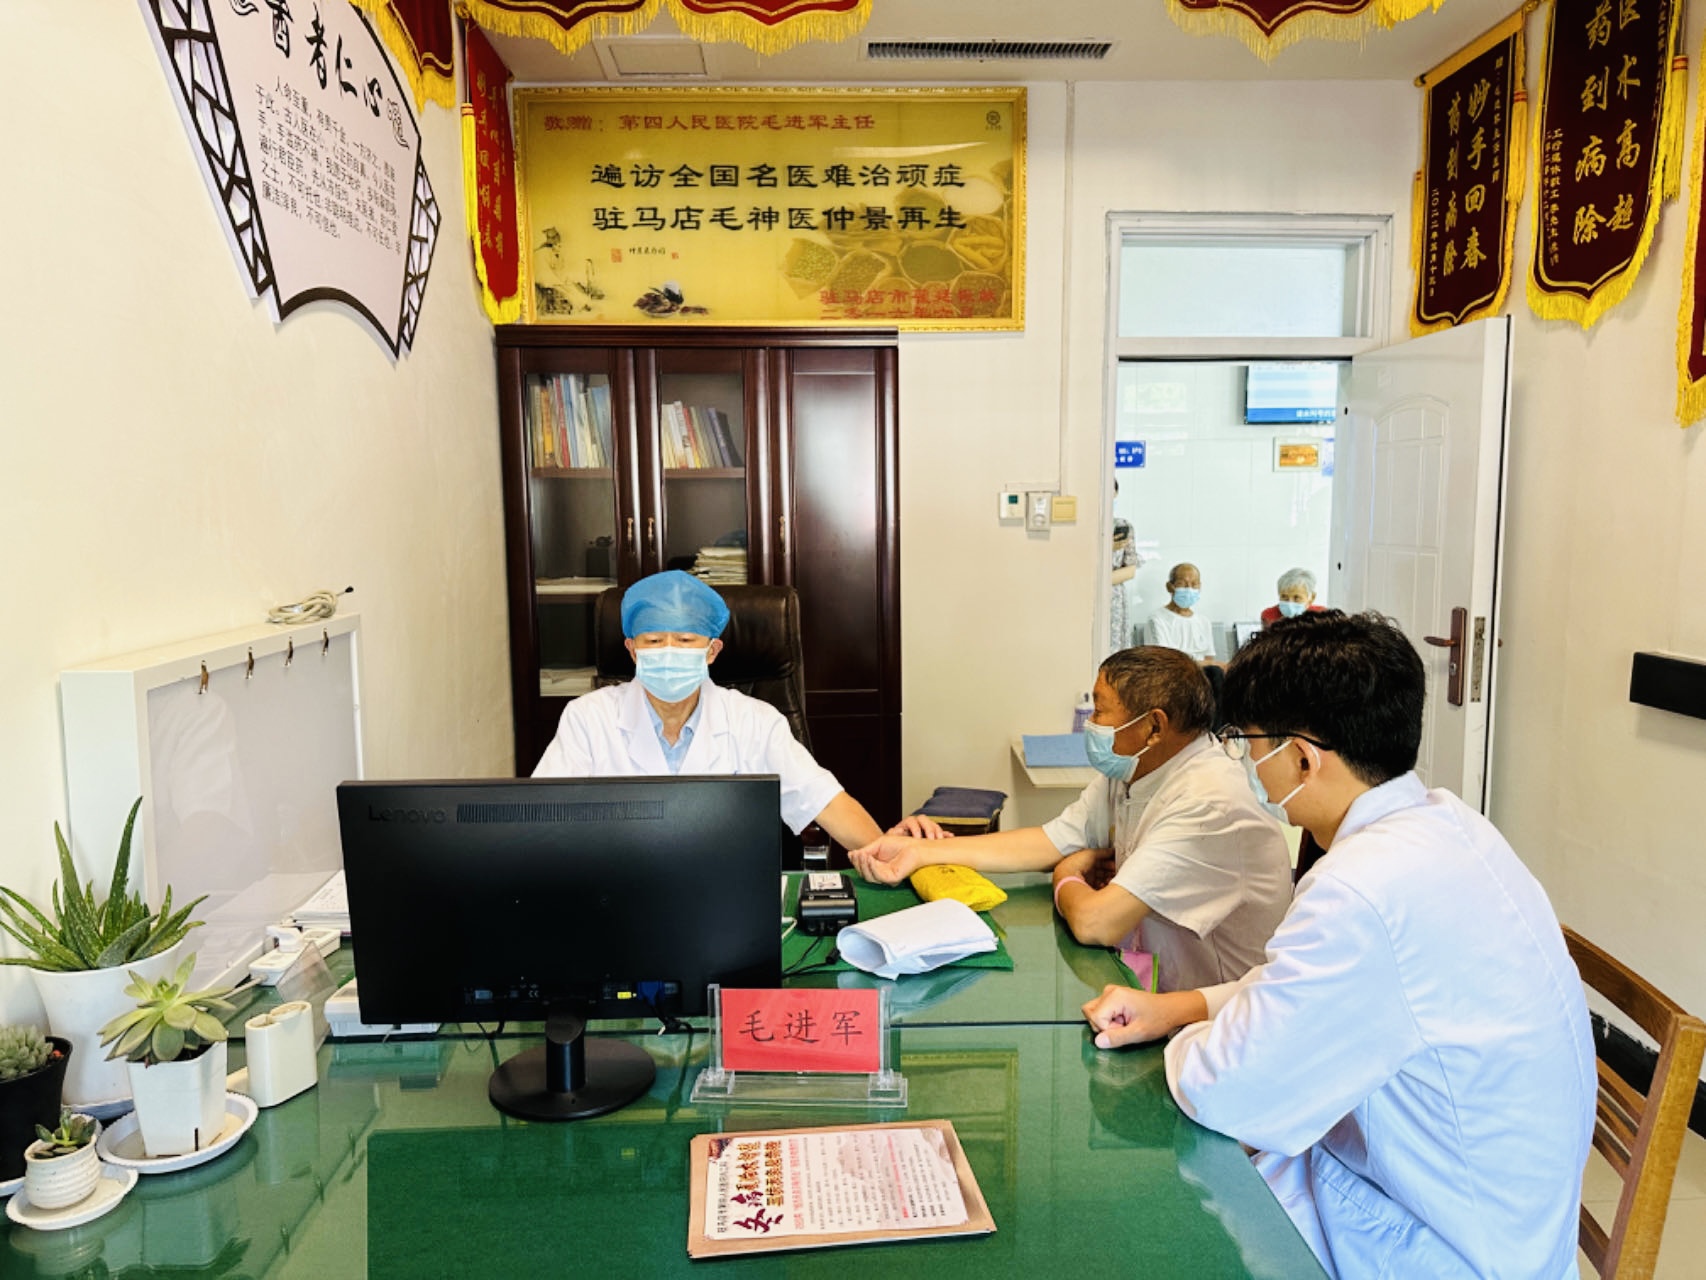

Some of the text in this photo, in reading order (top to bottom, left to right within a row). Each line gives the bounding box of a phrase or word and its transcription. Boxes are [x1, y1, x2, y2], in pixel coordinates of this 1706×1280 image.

[1572, 1, 1613, 245] 药到病除
[591, 163, 966, 188] 遍访全国名医难治顽症
[1442, 90, 1462, 277] 药到病除
[1459, 78, 1491, 271] 妙手回春
[592, 206, 967, 231] 驻马店毛神医仲景再生
[367, 805, 447, 824] Lenovo
[738, 1009, 863, 1045] 毛进军
